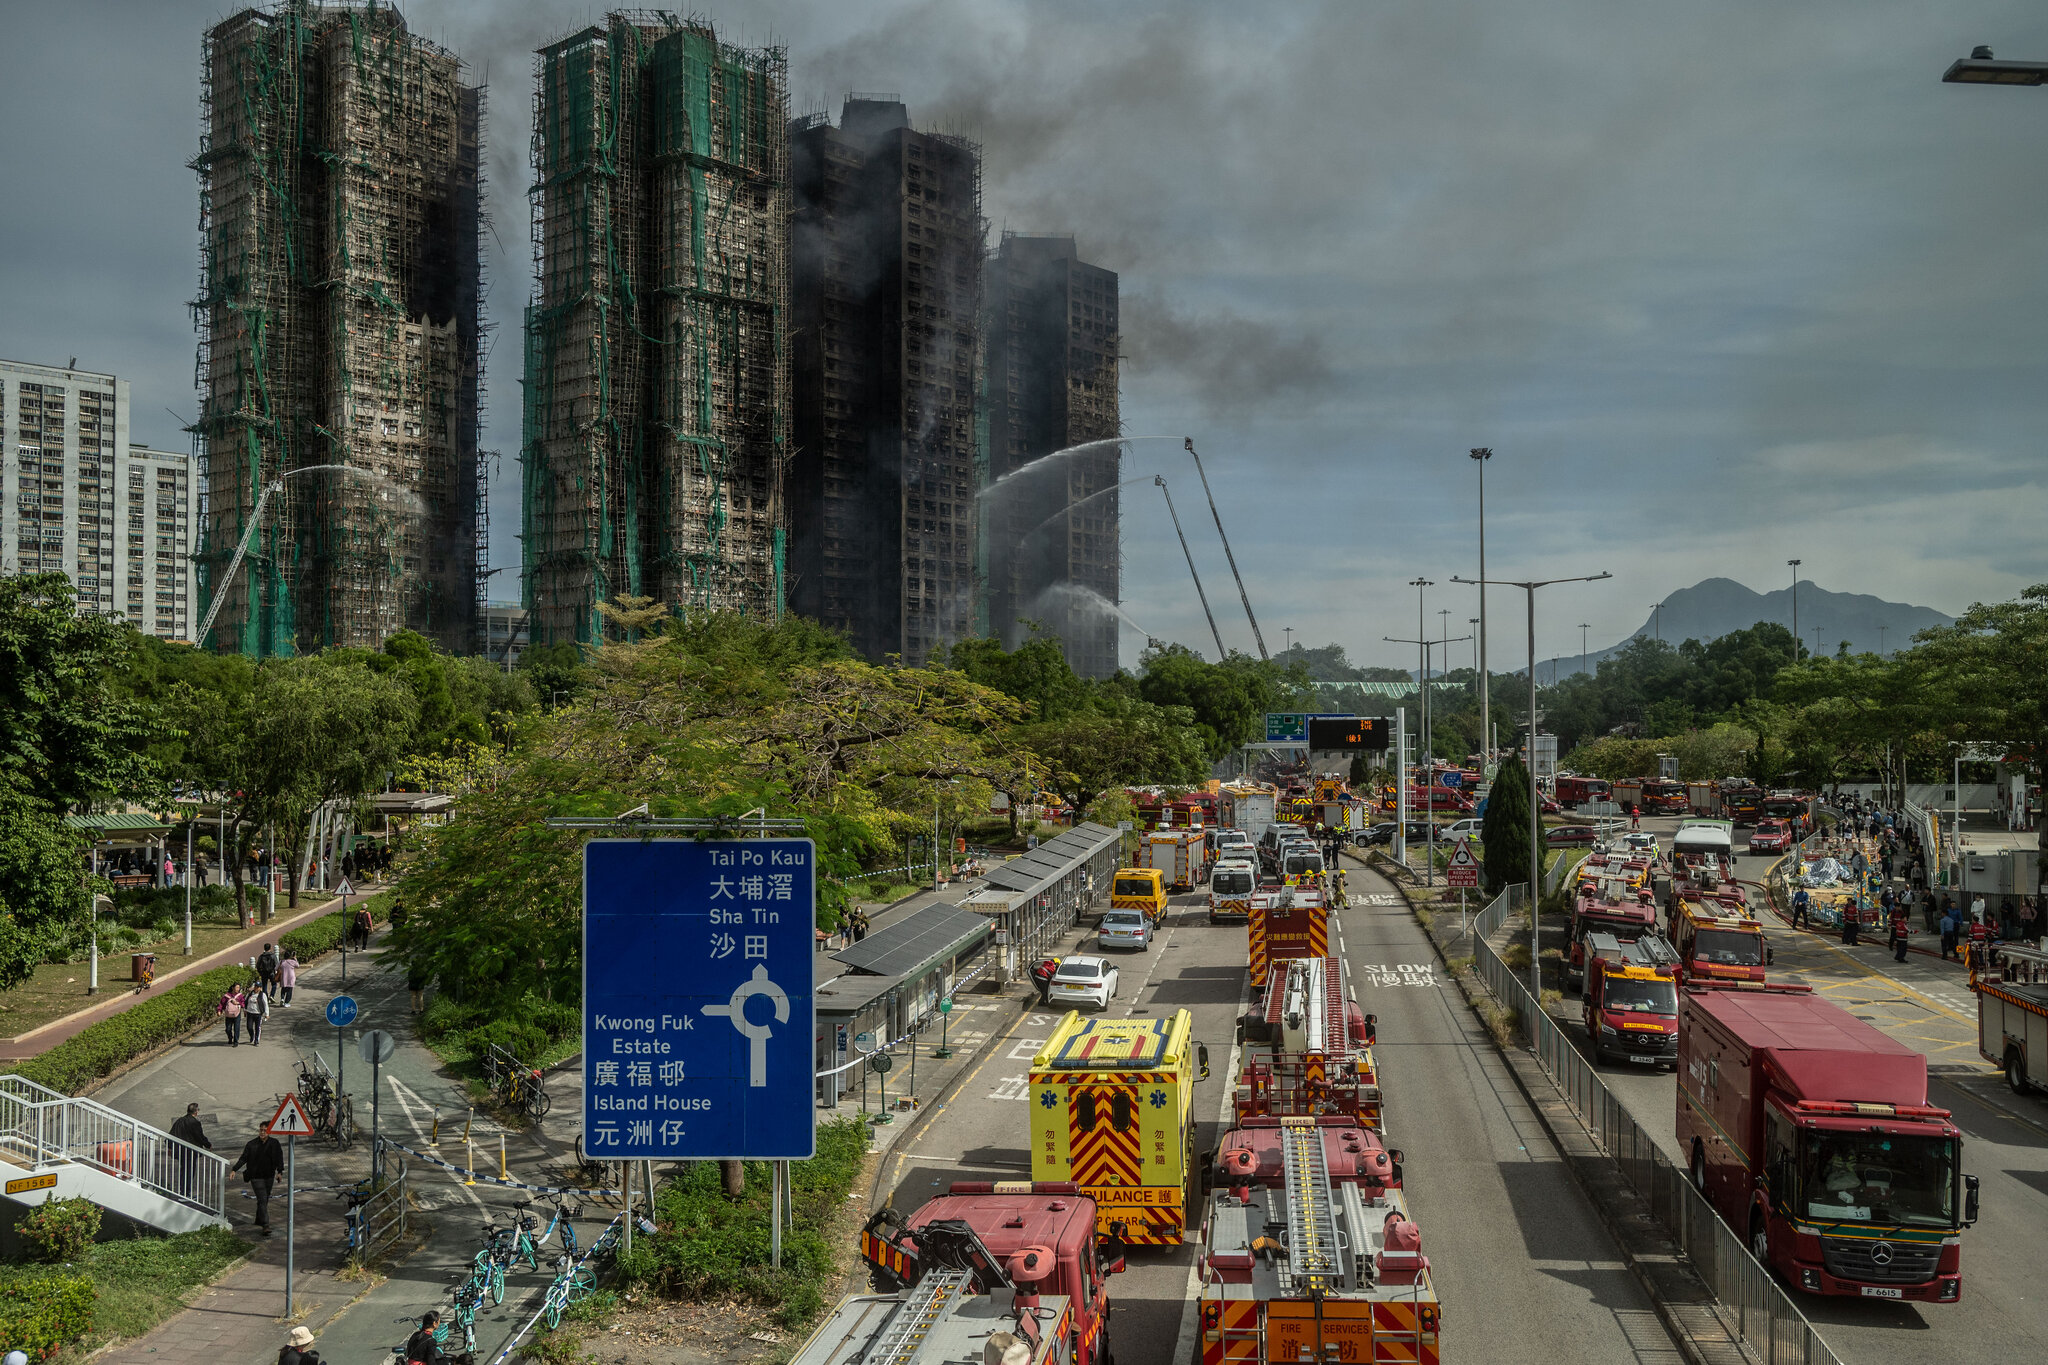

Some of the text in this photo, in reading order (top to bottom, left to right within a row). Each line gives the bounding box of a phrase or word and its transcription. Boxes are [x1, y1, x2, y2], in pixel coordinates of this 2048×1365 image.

[709, 850, 805, 866] Tai Po Kau
[709, 874, 792, 901] 大埔滘
[709, 908, 779, 924] Sha Tin
[709, 932, 768, 960] 沙田
[1364, 964, 1433, 973] SLOW
[595, 1015, 694, 1033] Kwong Fuk
[612, 1038, 671, 1054] Estate
[594, 1060, 685, 1087] 廣福邨
[594, 1094, 712, 1111] Island House
[594, 1120, 685, 1146] 元洲仔
[1046, 1130, 1056, 1165] 勿緊隨
[1154, 1129, 1165, 1165] 勿緊隨
[1158, 1190, 1172, 1204] 護
[1876, 1289, 1896, 1297] 6615
[1281, 1324, 1369, 1334] FIRE SERVICES
[1282, 1339, 1358, 1360] 消 防
